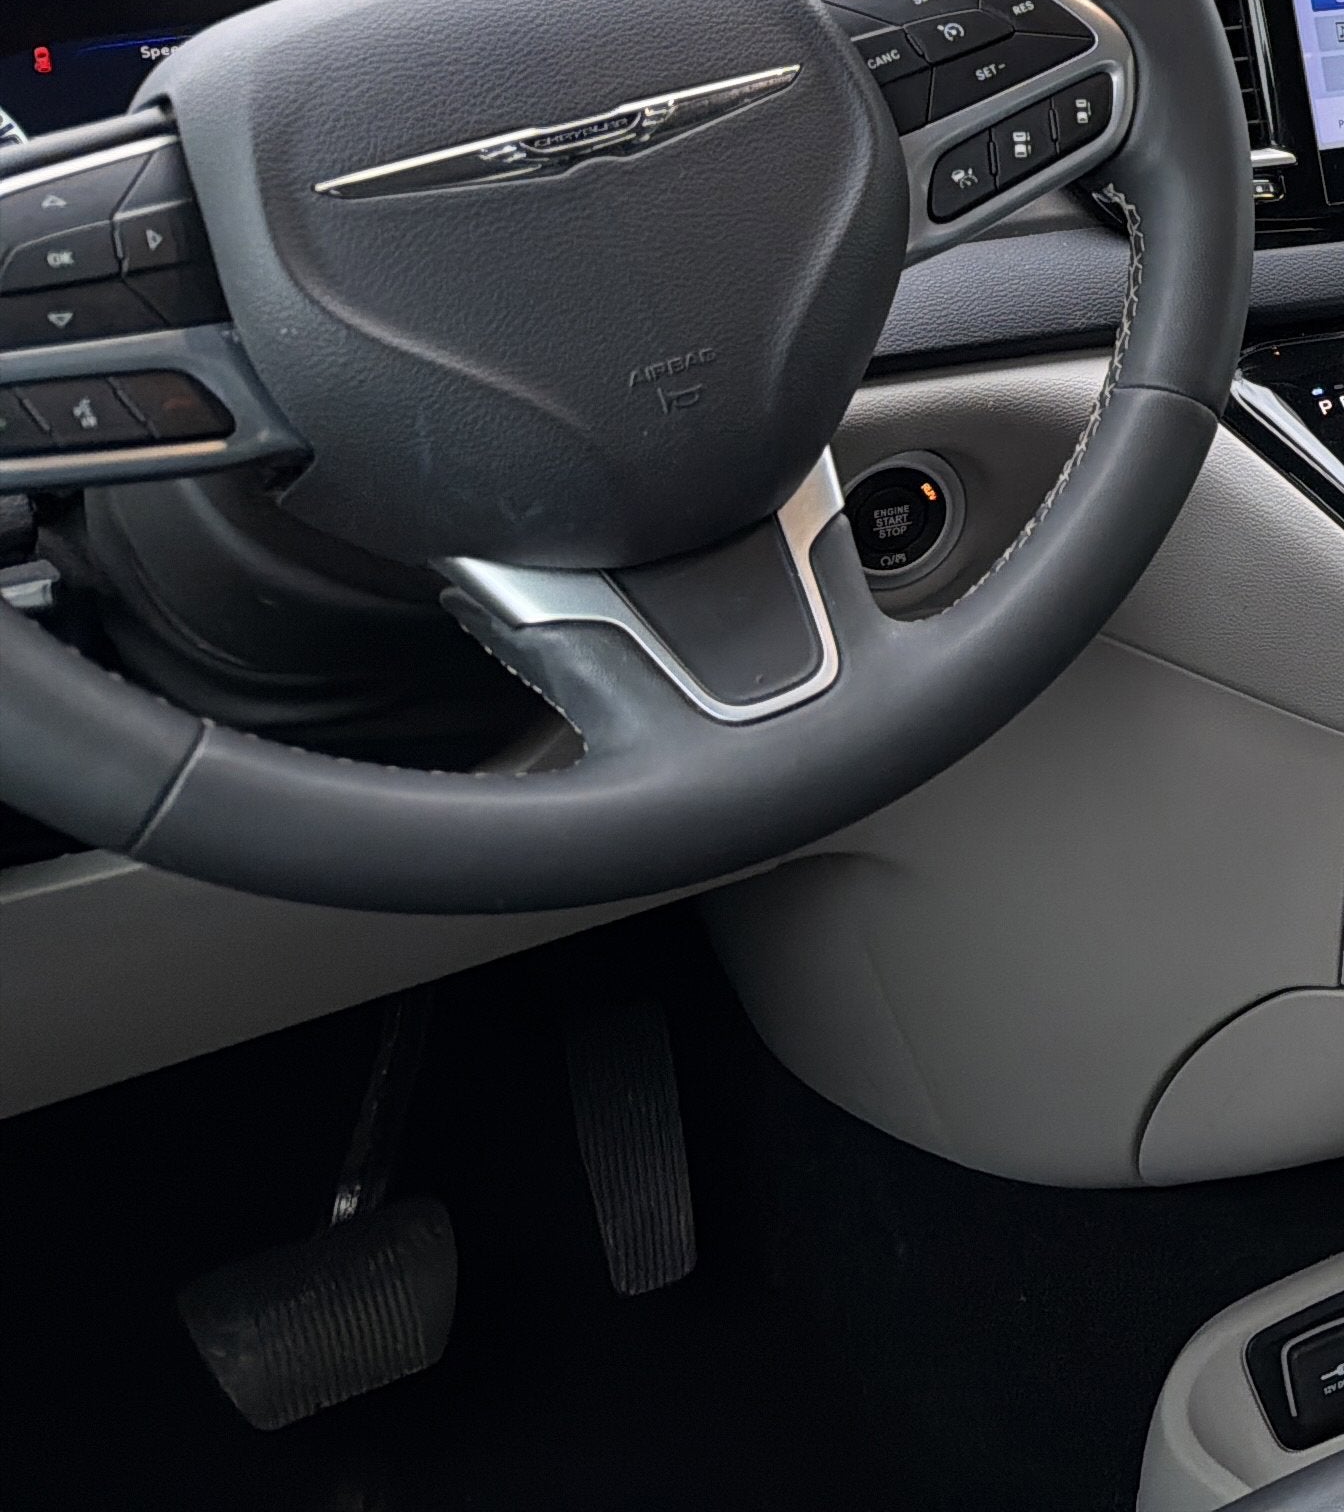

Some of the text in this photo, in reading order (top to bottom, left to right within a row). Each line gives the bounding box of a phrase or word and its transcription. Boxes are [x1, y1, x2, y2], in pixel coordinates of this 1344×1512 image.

[1012, 0, 1035, 16] RES
[867, 49, 901, 70] CANC
[46, 251, 75, 268] OK
[628, 347, 717, 388] AIRBAG
[921, 482, 937, 501] RUN
[873, 504, 910, 519] ENGINE
[875, 514, 909, 528] START
[878, 525, 908, 539] STOP
